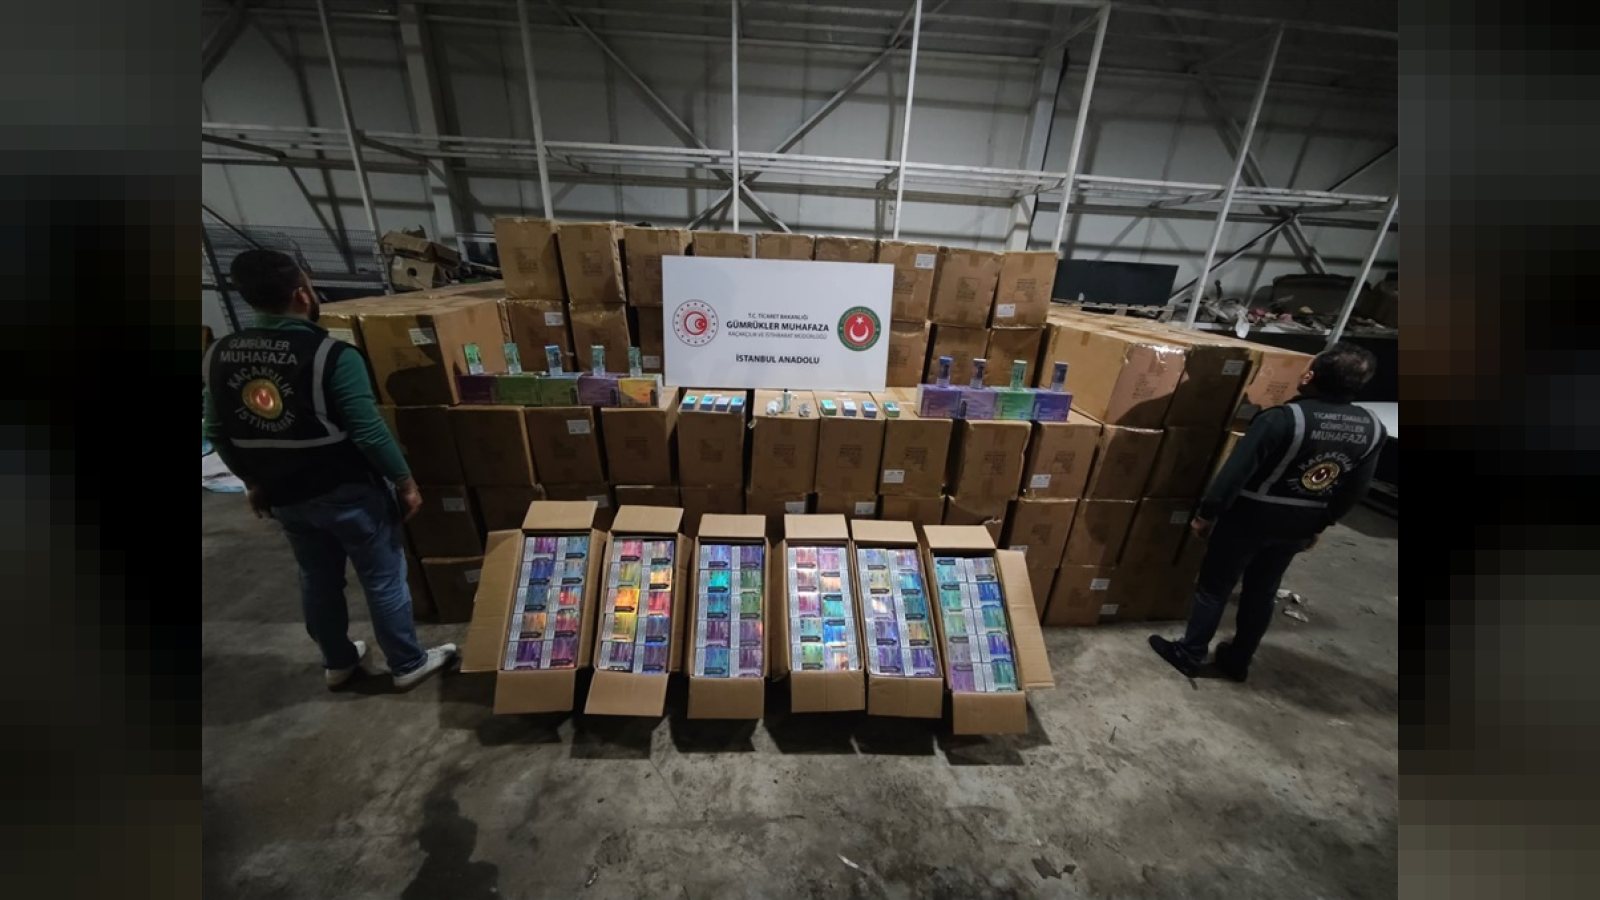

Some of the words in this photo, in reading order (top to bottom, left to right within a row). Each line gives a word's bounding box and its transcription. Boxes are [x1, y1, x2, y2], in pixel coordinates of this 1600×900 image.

[726, 320, 780, 330] GÜMRÜKLER
[781, 322, 829, 332] MUHAFAZA
[220, 350, 298, 366] MUHAFAZA
[736, 354, 777, 363] İSTANBUL
[779, 355, 820, 365] ANADOLU
[1311, 430, 1367, 444] MUHAFAZA
